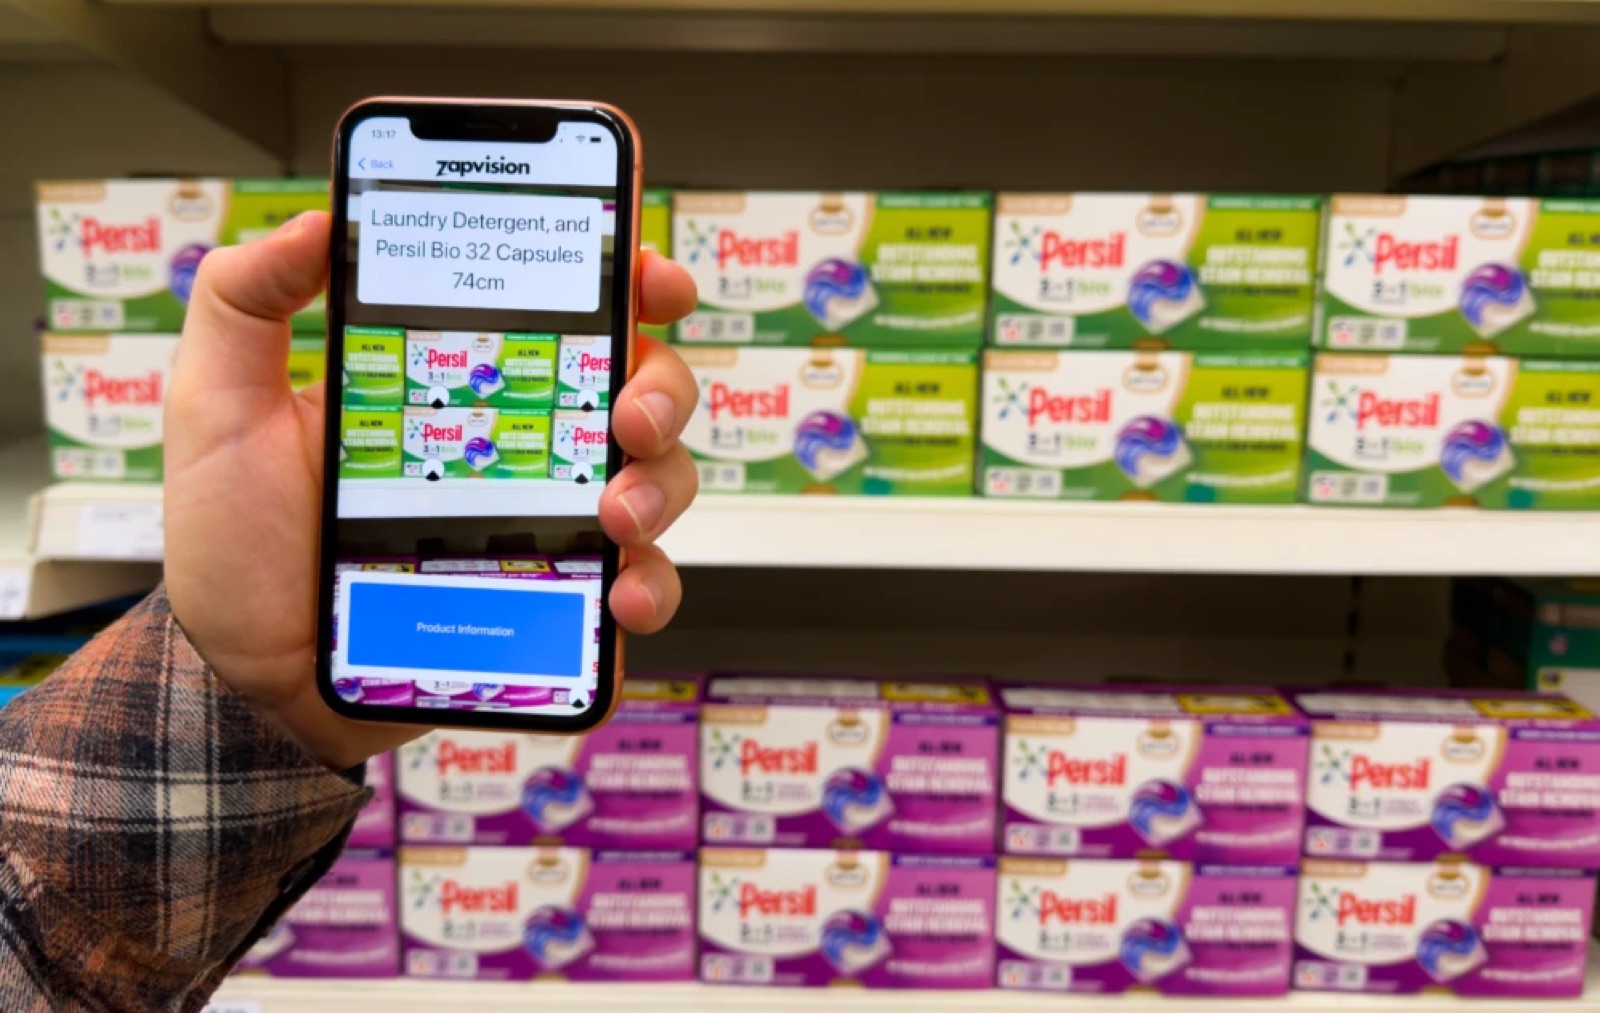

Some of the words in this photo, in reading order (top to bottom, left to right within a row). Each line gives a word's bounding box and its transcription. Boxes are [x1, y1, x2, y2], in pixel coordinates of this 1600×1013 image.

[371, 129, 397, 139] 13:17
[371, 159, 395, 169] Back
[436, 155, 531, 177] zapvision
[80, 217, 161, 257] Persil
[371, 209, 448, 231] Laundry
[453, 211, 551, 235] Detergent,
[555, 216, 591, 233] and
[376, 239, 427, 258] Persil
[431, 241, 461, 260] Bio
[466, 243, 491, 261] 32
[496, 244, 585, 266] Capsules
[718, 229, 799, 270] Persil
[1040, 231, 1126, 272] Persil
[1374, 232, 1459, 274] Persil
[452, 272, 506, 291] 74cm
[427, 348, 468, 369] Persil
[580, 353, 611, 373] Pers
[85, 370, 163, 407] Persil
[710, 382, 790, 421] Persil
[1028, 387, 1112, 427] Persil
[1357, 391, 1441, 431] Persil
[422, 423, 463, 442] Persil
[416, 621, 456, 634] Product
[458, 624, 514, 637] Information
[438, 740, 517, 776] Persil
[741, 738, 818, 777] Persil
[1047, 750, 1127, 787] Persil
[1350, 755, 1431, 792] Persil
[442, 879, 518, 915] Persil
[740, 882, 816, 919] Persil
[1039, 890, 1118, 926] Persil
[1338, 891, 1416, 927] Persil
